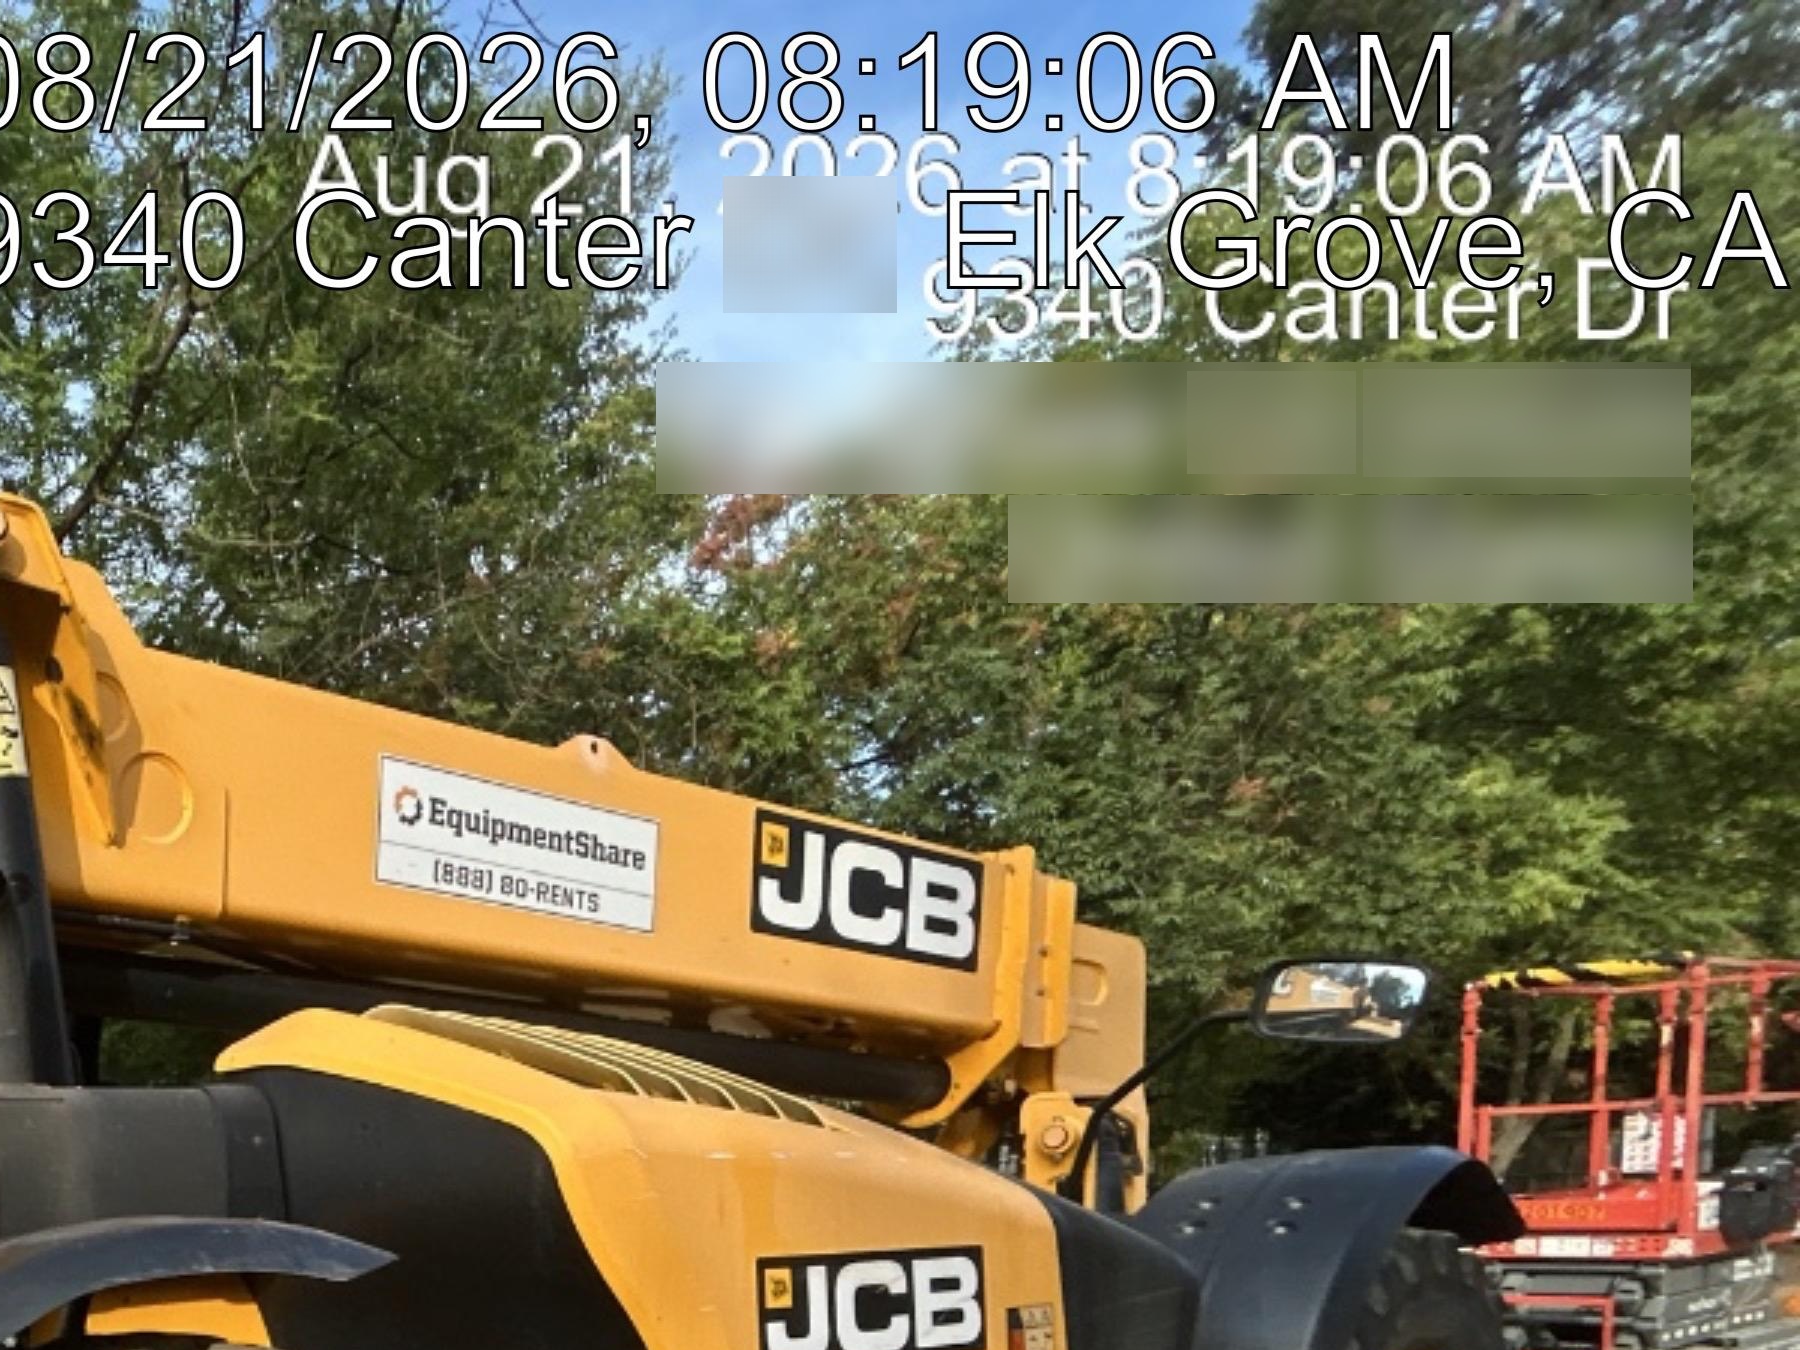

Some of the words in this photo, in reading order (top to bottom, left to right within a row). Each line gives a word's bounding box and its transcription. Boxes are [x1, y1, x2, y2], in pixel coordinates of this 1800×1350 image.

[427, 796, 646, 871] EquipmentShare
[432, 858, 493, 894] (888)
[500, 875, 600, 913] 80-RENTS
[757, 830, 978, 960] JCB
